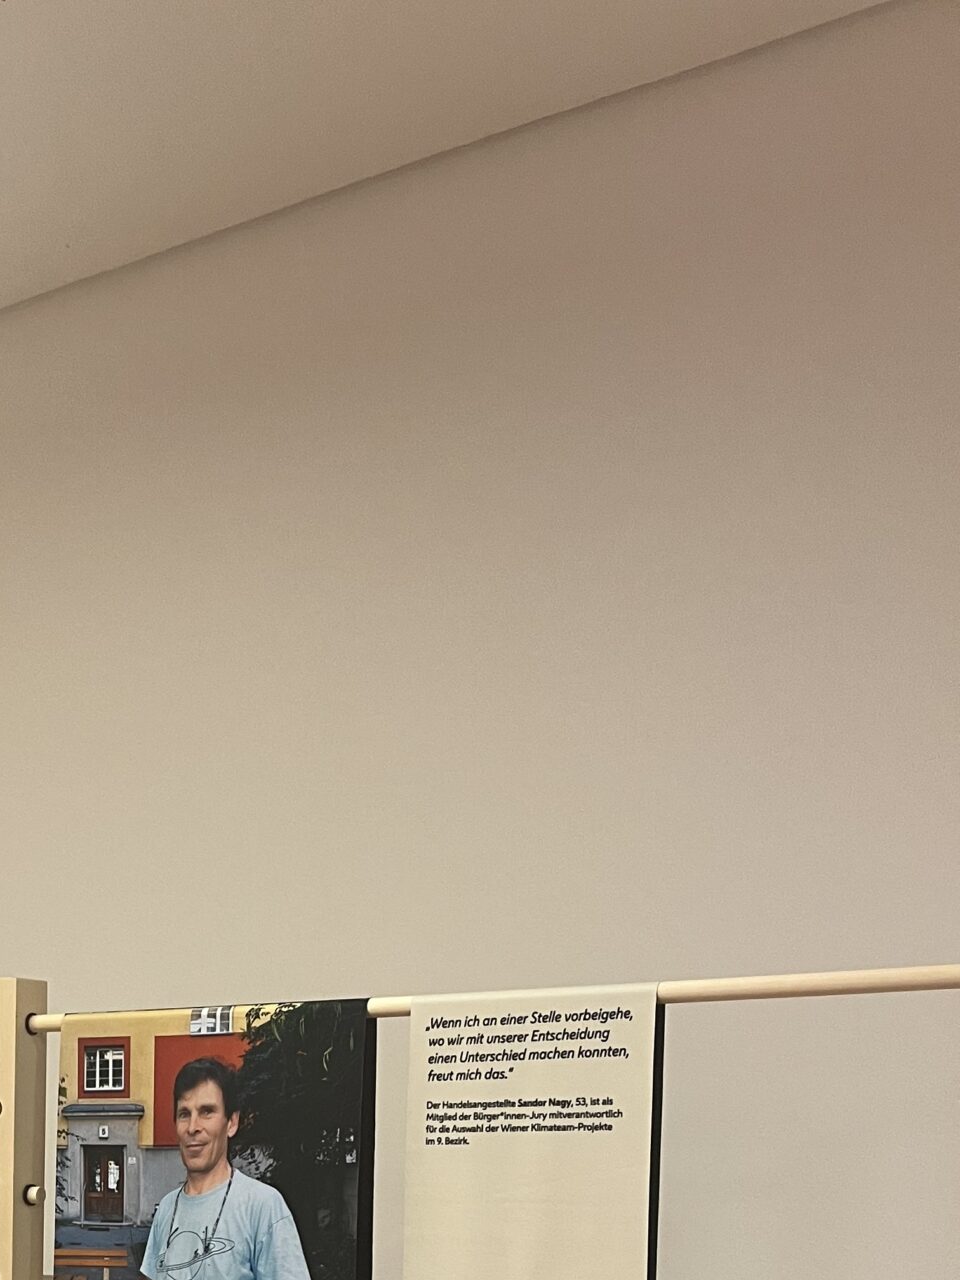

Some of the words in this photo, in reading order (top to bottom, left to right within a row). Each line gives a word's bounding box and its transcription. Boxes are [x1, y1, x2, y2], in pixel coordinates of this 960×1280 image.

[463, 1015, 480, 1027] ich
[482, 1017, 497, 1026] an
[499, 1013, 529, 1025] einer
[529, 1011, 562, 1024] Stelle
[564, 1008, 633, 1023] vorbeigehe,
[428, 1037, 445, 1046] wo
[447, 1034, 464, 1046] wir
[465, 1033, 484, 1045] mit
[486, 1033, 529, 1044] unserer
[530, 1028, 610, 1042] Entscheidung
[427, 1052, 457, 1064] einen
[459, 1049, 527, 1063] Unterschied
[528, 1047, 575, 1060] machen
[577, 1046, 629, 1058] konnten,
[427, 1070, 454, 1081] freut
[455, 1068, 482, 1080] mich
[426, 1100, 441, 1109] Der
[548, 1098, 573, 1109] Nagy,
[575, 1097, 588, 1107] 53,
[589, 1097, 600, 1106] ist
[601, 1096, 613, 1105] als
[425, 1112, 457, 1123] Mitglied
[458, 1112, 472, 1121] der
[548, 1109, 623, 1119] mitverantwortlich
[438, 1124, 450, 1133] die
[451, 1124, 483, 1133] Auswahl
[484, 1124, 499, 1132] der
[500, 1123, 530, 1132] Wiener
[530, 1122, 613, 1132] Klimateam-Projekte
[425, 1137, 435, 1145] im
[436, 1136, 443, 1145] 9.
[444, 1136, 470, 1145] Bezirk.
